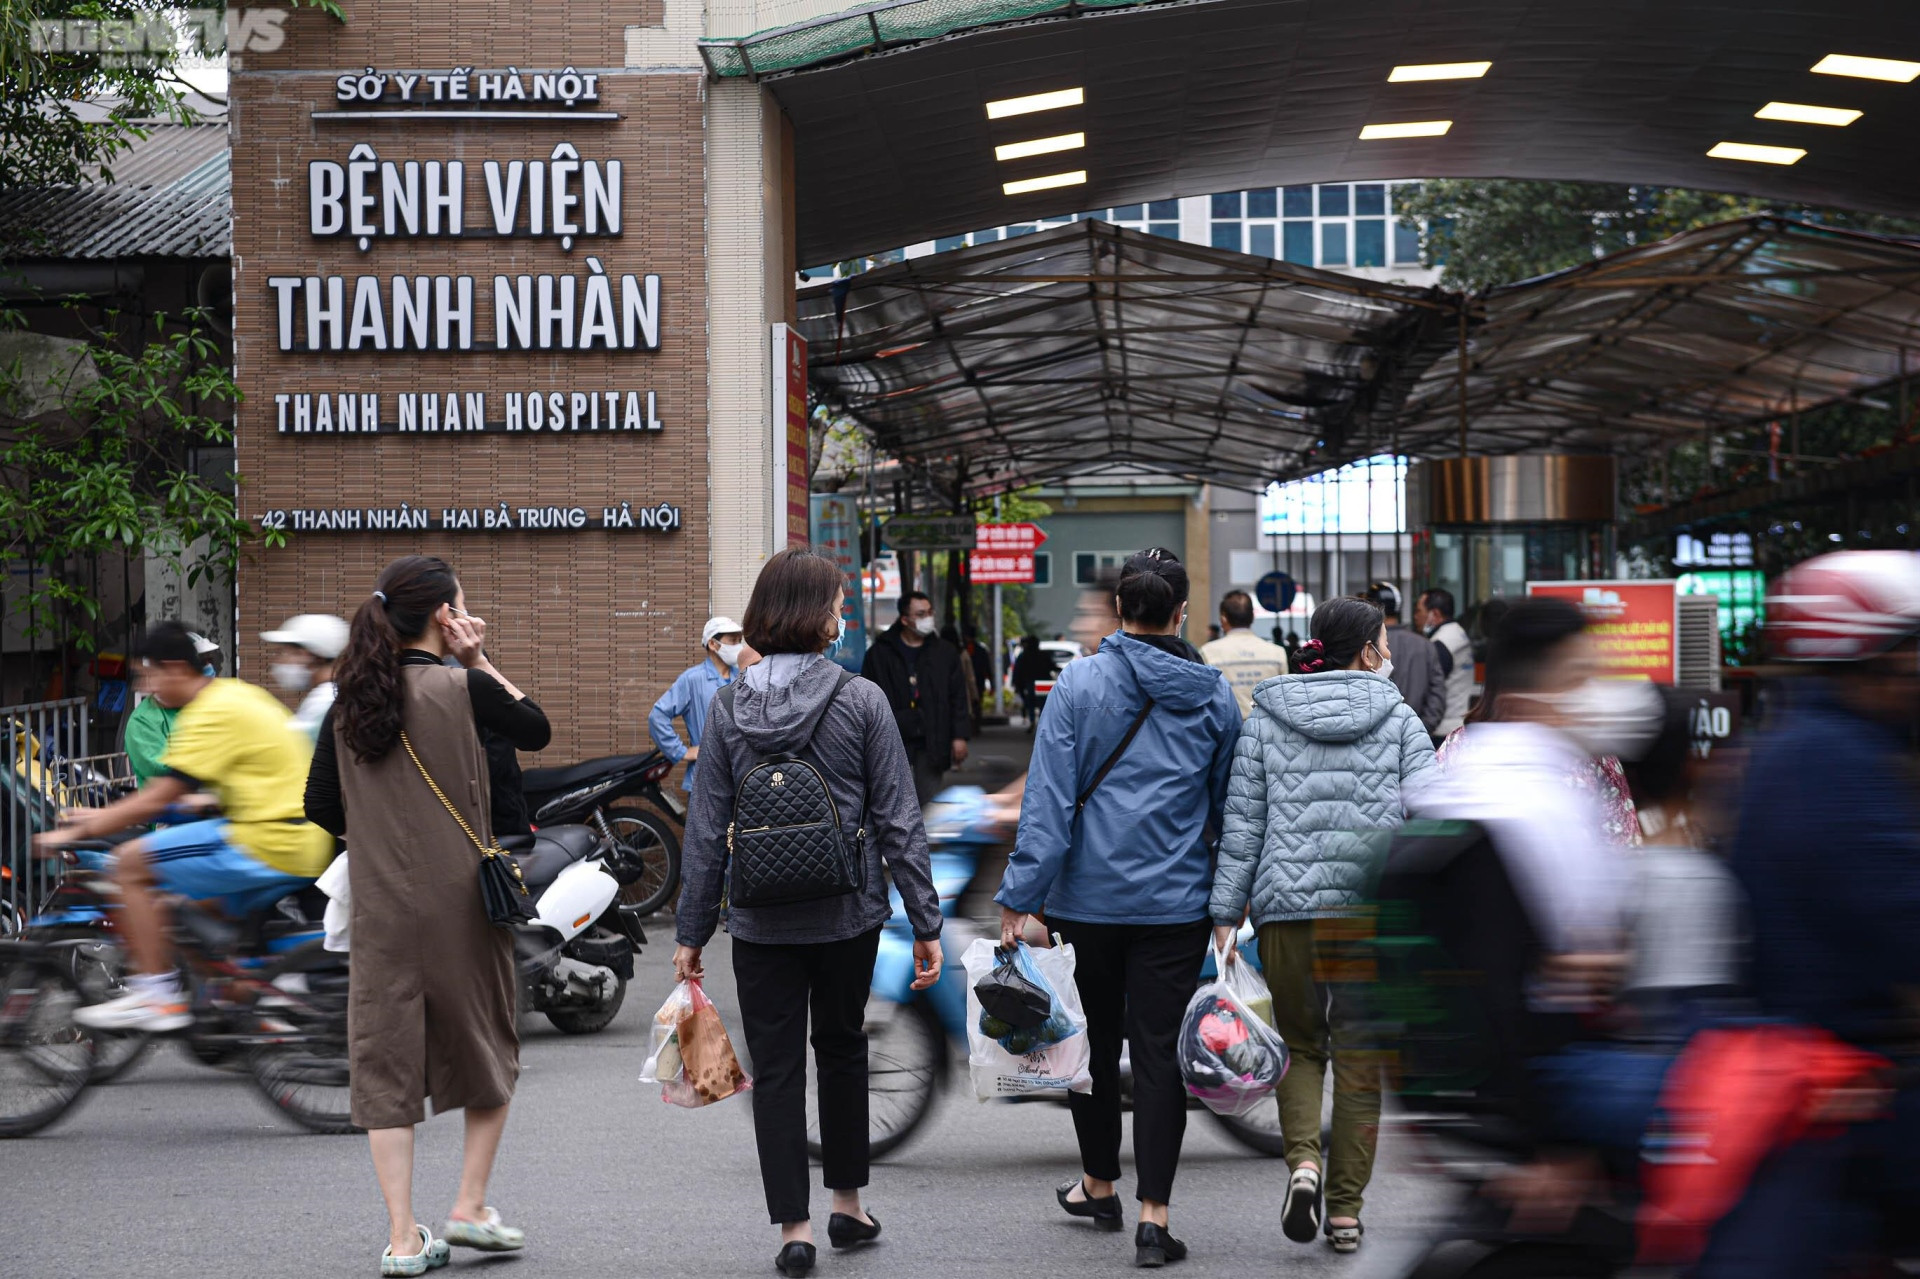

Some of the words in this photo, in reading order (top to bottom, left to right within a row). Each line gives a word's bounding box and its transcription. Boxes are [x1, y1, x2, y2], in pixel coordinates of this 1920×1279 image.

[336, 67, 386, 100] SỞ
[395, 75, 418, 100] Y
[428, 67, 471, 100] TẾ
[479, 67, 526, 100] HÀ
[533, 66, 598, 106] NỘI
[309, 143, 463, 251] BỆNH
[483, 142, 621, 250] VIỆN
[268, 275, 472, 350] THANH
[494, 256, 659, 349] NHÀN
[275, 393, 378, 432] THANH
[398, 392, 484, 431] NHAN
[505, 391, 661, 431] HOSPITAL
[261, 510, 286, 529] 42
[291, 510, 361, 529] THANH
[367, 503, 427, 529] NHÀN
[442, 509, 478, 528] HAI
[484, 502, 512, 528] BÀ
[517, 506, 586, 528] TRƯNG
[603, 502, 634, 527] HÀ
[640, 503, 679, 531] NỘI
